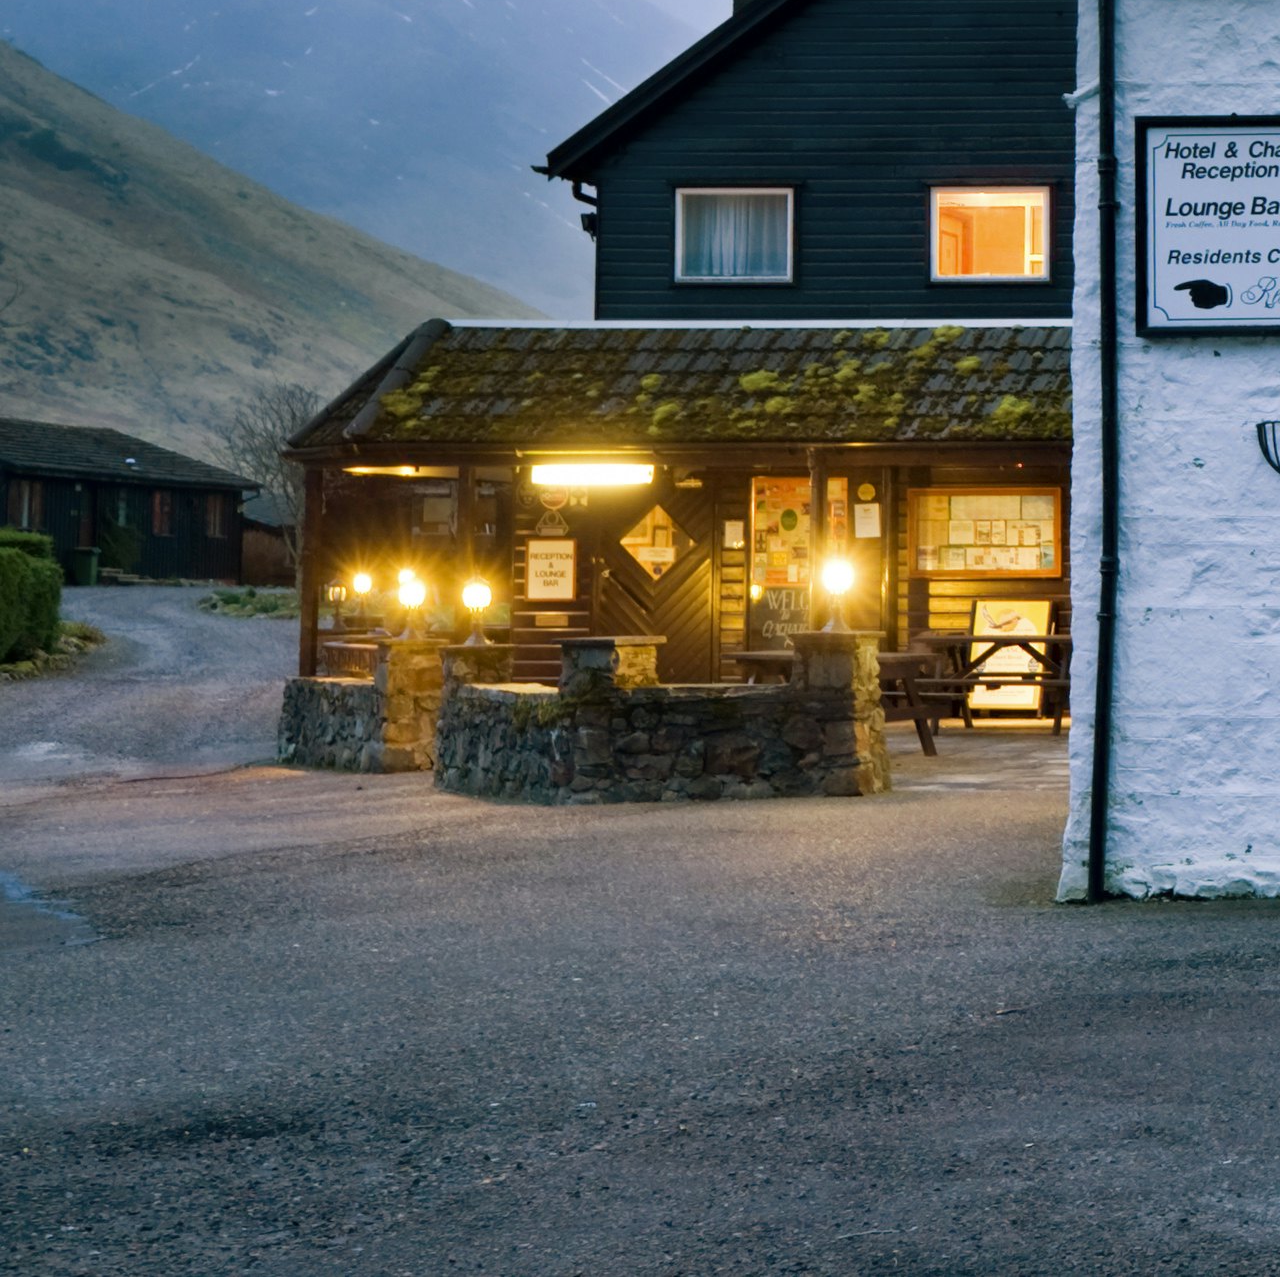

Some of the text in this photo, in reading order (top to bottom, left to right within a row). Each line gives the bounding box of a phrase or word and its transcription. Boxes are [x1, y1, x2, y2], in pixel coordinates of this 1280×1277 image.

[1164, 142, 1216, 159] Hotel
[1224, 141, 1238, 158] &
[1182, 161, 1279, 181] Reception
[1166, 198, 1245, 220] Lounge
[1168, 250, 1261, 264] Residents
[530, 552, 573, 560] RECEPTION
[535, 570, 567, 578] LOUNGE
[543, 579, 559, 587] BAR
